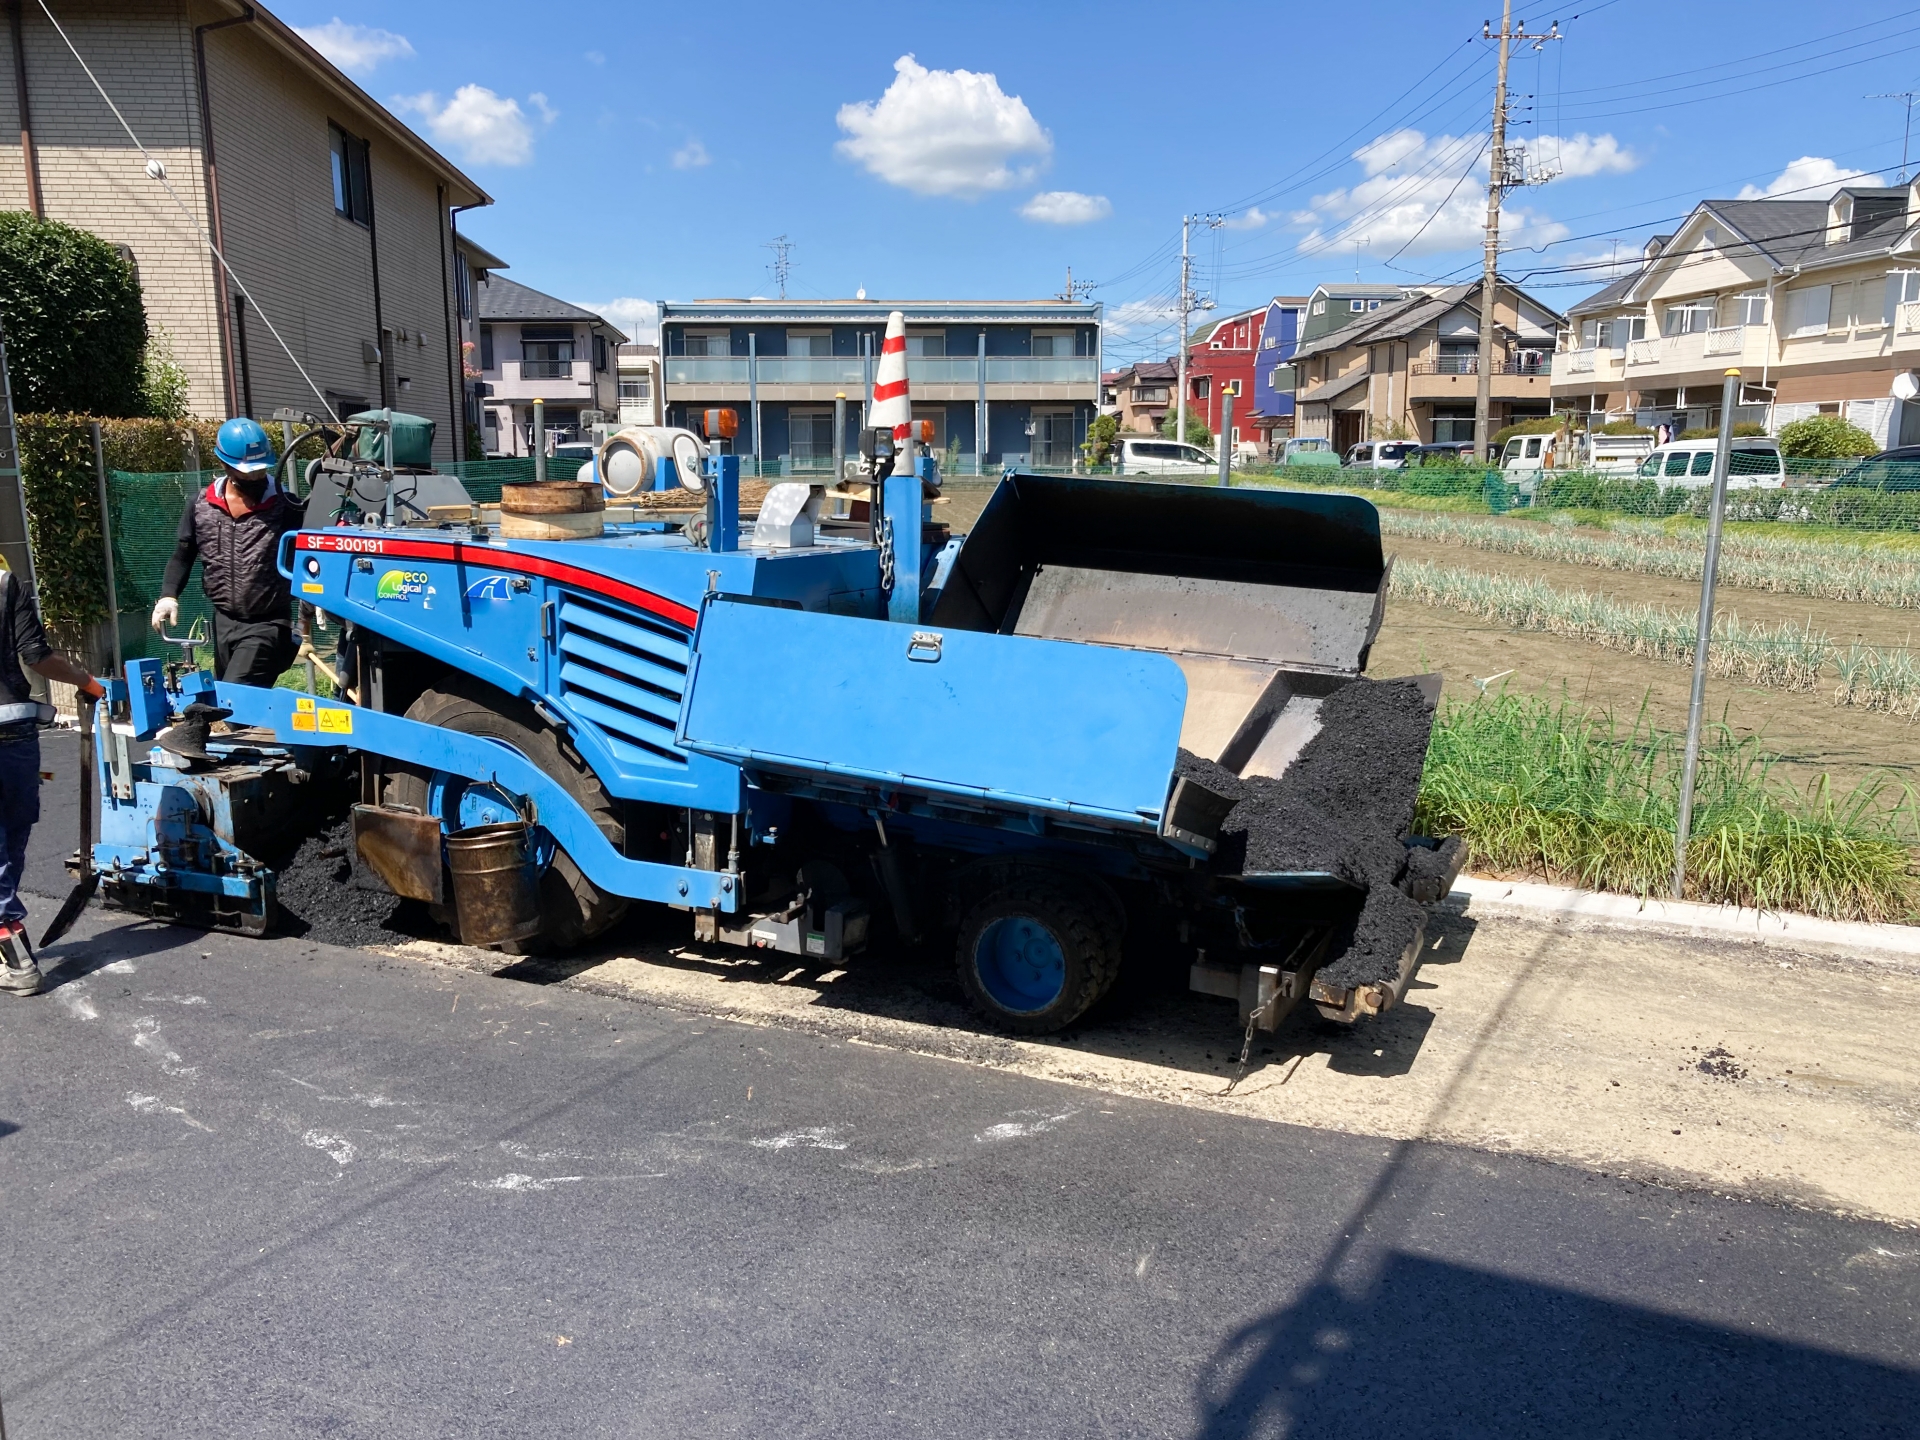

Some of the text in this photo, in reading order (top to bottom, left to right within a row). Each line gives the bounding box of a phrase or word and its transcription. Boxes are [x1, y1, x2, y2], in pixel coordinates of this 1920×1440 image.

[307, 535, 384, 553] SF-300191
[404, 571, 428, 584] eco
[378, 592, 409, 601] CONTROL
